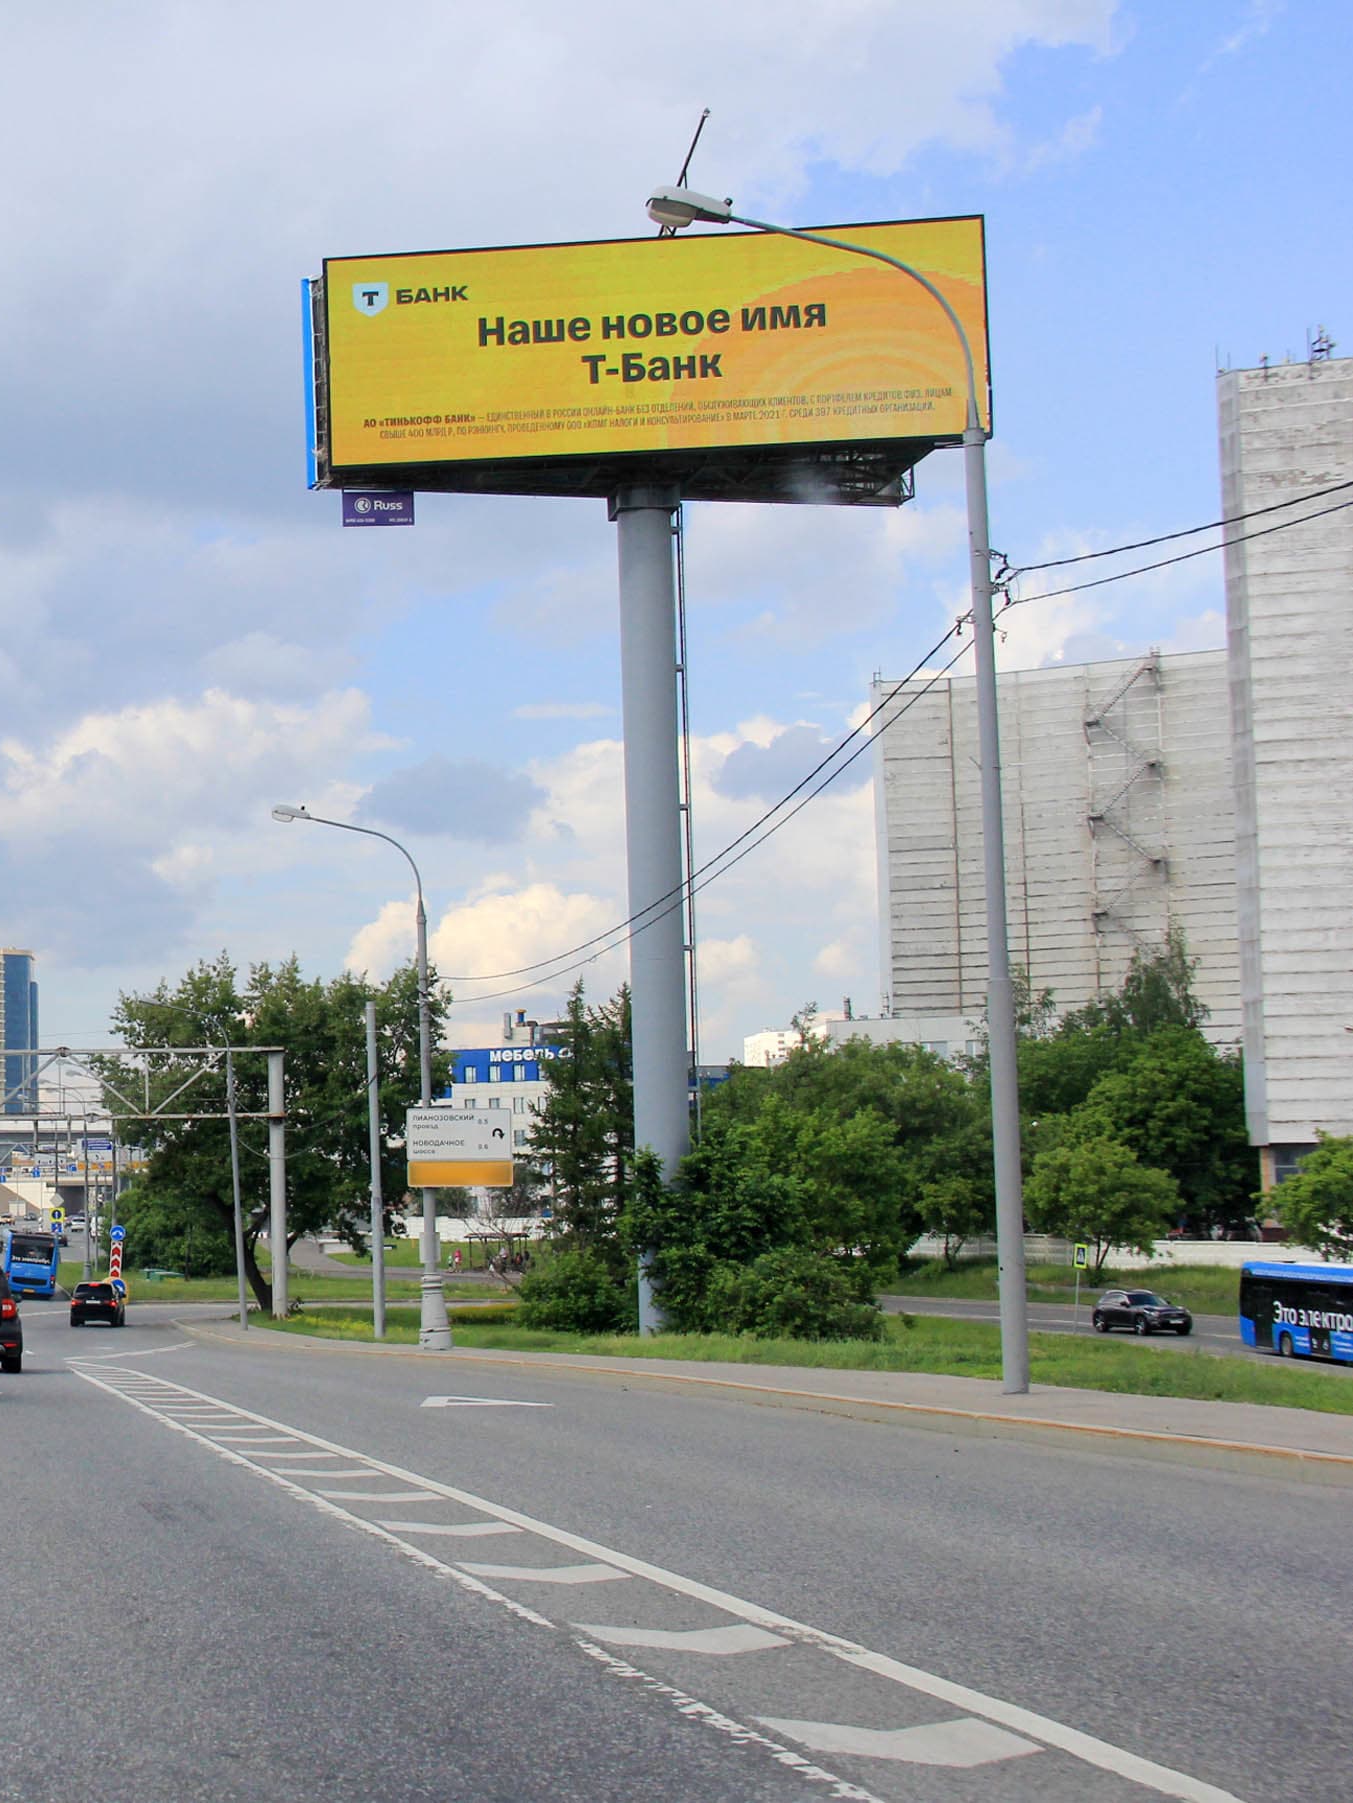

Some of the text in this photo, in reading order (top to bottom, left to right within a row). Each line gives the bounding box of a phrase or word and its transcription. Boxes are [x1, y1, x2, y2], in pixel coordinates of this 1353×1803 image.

[396, 285, 468, 305] БАНК
[478, 303, 826, 347] Наше новое имя
[581, 352, 722, 384] Т-Банк
[364, 419, 376, 428] АО
[379, 415, 441, 427] «ТИНЬКОФФ
[444, 413, 476, 424] БАНК»
[374, 500, 403, 510] Russ
[1272, 1300, 1297, 1325] Это
